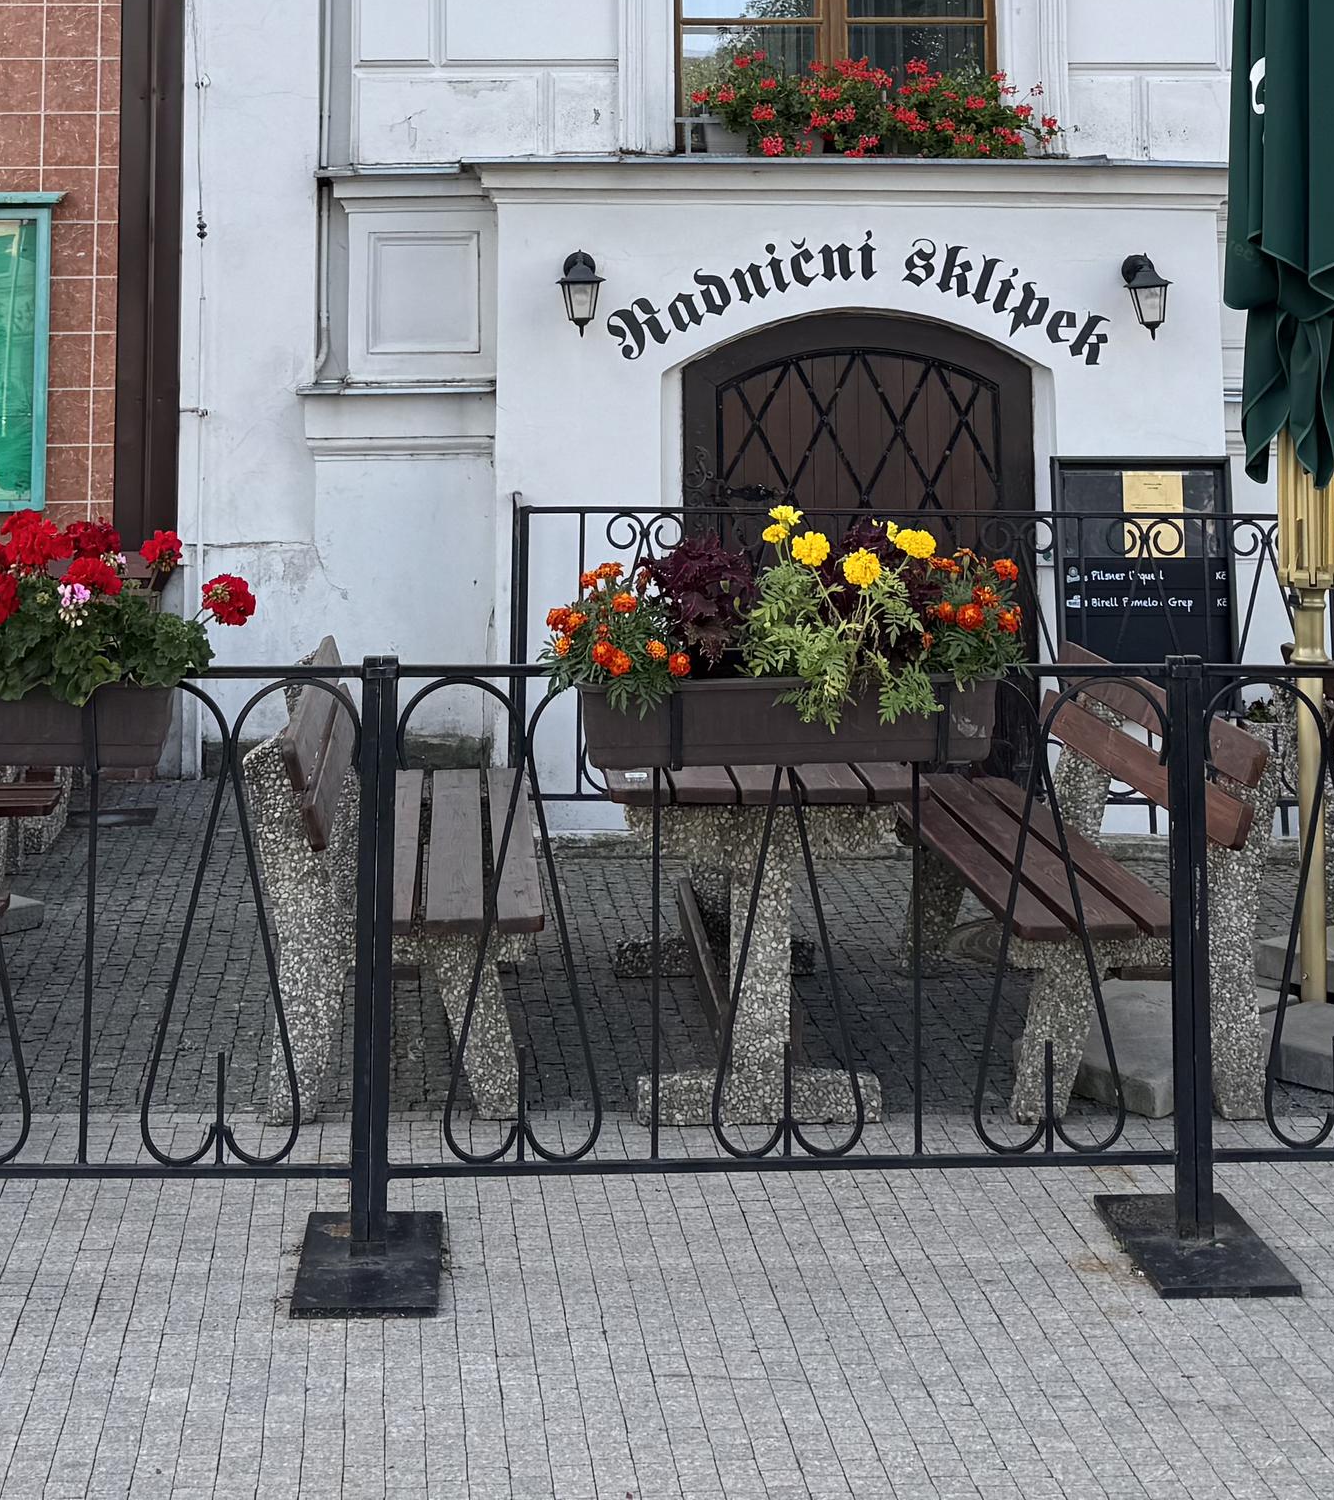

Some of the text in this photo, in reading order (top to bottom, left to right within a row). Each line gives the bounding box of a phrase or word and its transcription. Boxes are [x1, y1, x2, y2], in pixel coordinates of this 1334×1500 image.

[607, 229, 878, 360] Radniční
[1090, 569, 1126, 581] Pilsner
[1091, 597, 1119, 607] Birell
[1167, 597, 1194, 613] Grep
